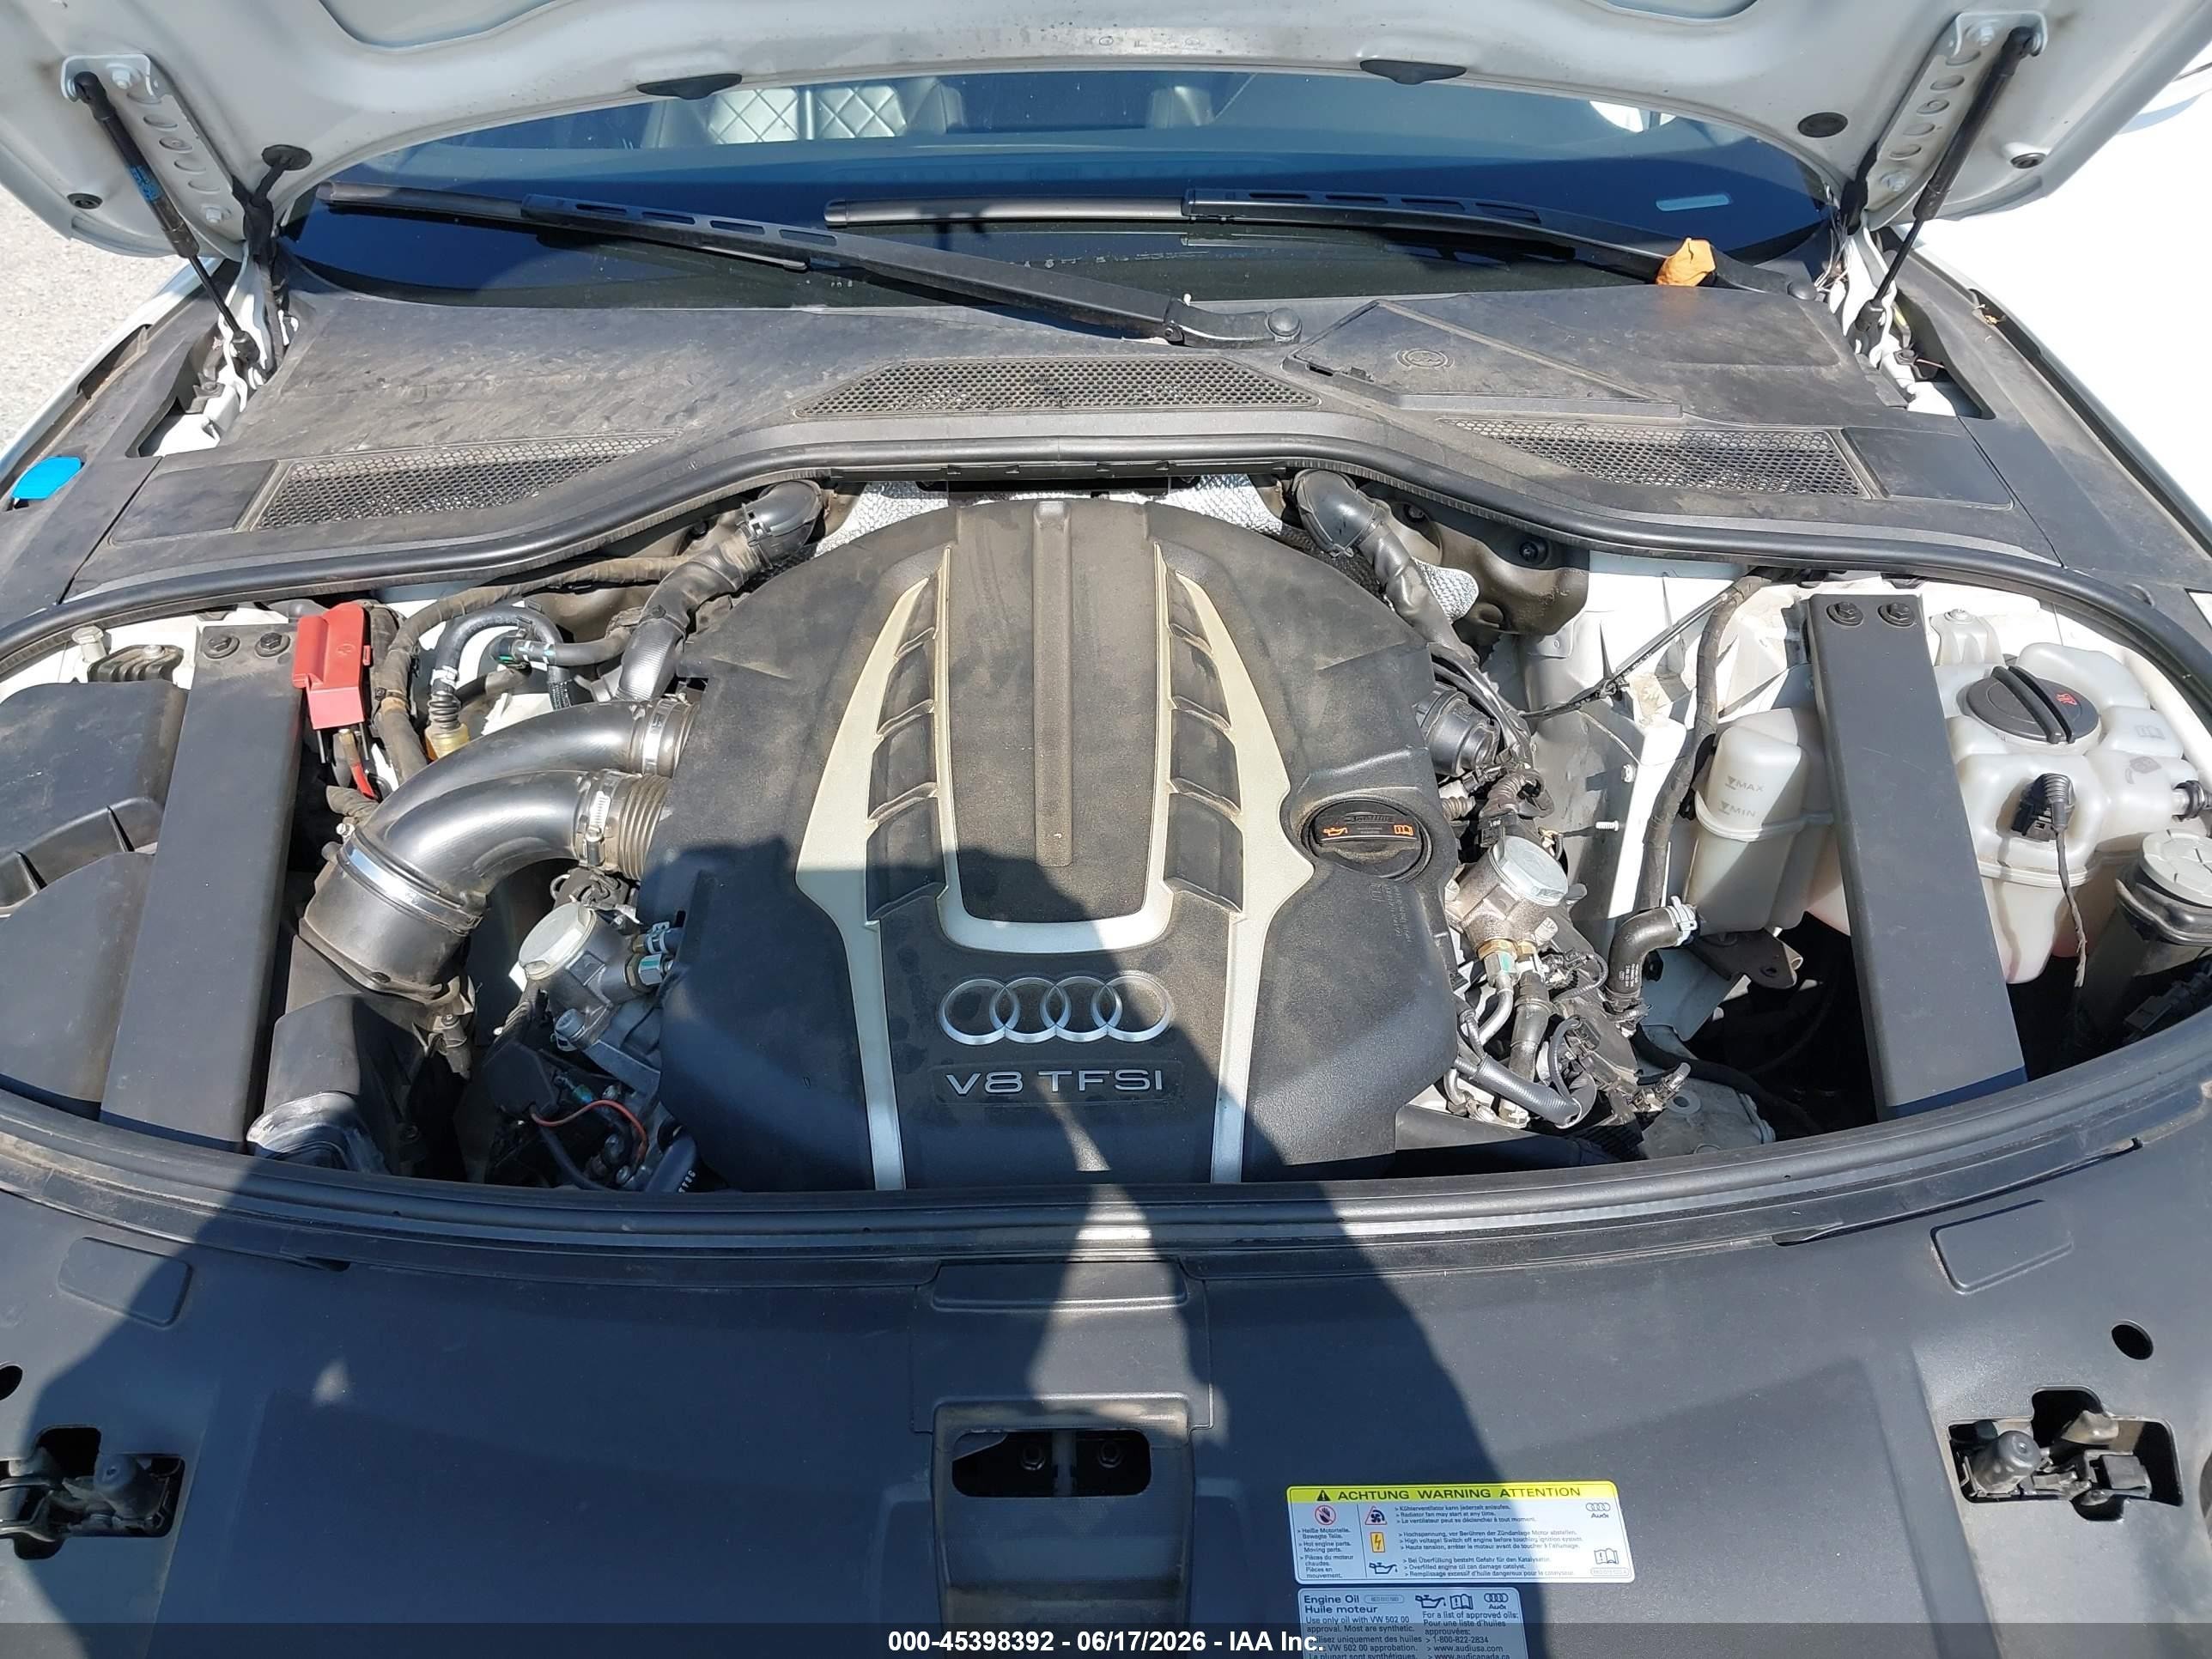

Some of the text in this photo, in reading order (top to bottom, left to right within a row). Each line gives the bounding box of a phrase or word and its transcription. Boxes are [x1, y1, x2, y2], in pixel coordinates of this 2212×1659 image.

[1735, 780, 1765, 792] MAX
[1729, 805, 1757, 817] MIN
[945, 1069, 1163, 1096] V8 TFSI
[1338, 1486, 1582, 1501] ACHTUNG WARNING ATTENTION
[1304, 1595, 1341, 1605] Engine
[1345, 1595, 1359, 1603] Oil
[1304, 1605, 1378, 1613] Huile moteur
[1322, 1616, 1339, 1626] only
[1340, 1615, 1350, 1624] oil
[1352, 1615, 1368, 1624] with
[1466, 1611, 1501, 1621] approved
[1458, 1619, 1475, 1627] liste
[1476, 1619, 1506, 1627] d'huiles
[1306, 1625, 1341, 1633] approval.
[1378, 1624, 1415, 1633] synthetic.
[1337, 1635, 1382, 1644] uniquement
[1370, 1644, 1418, 1653] approbation.
[1433, 1644, 1504, 1652] www.audiusa.com
